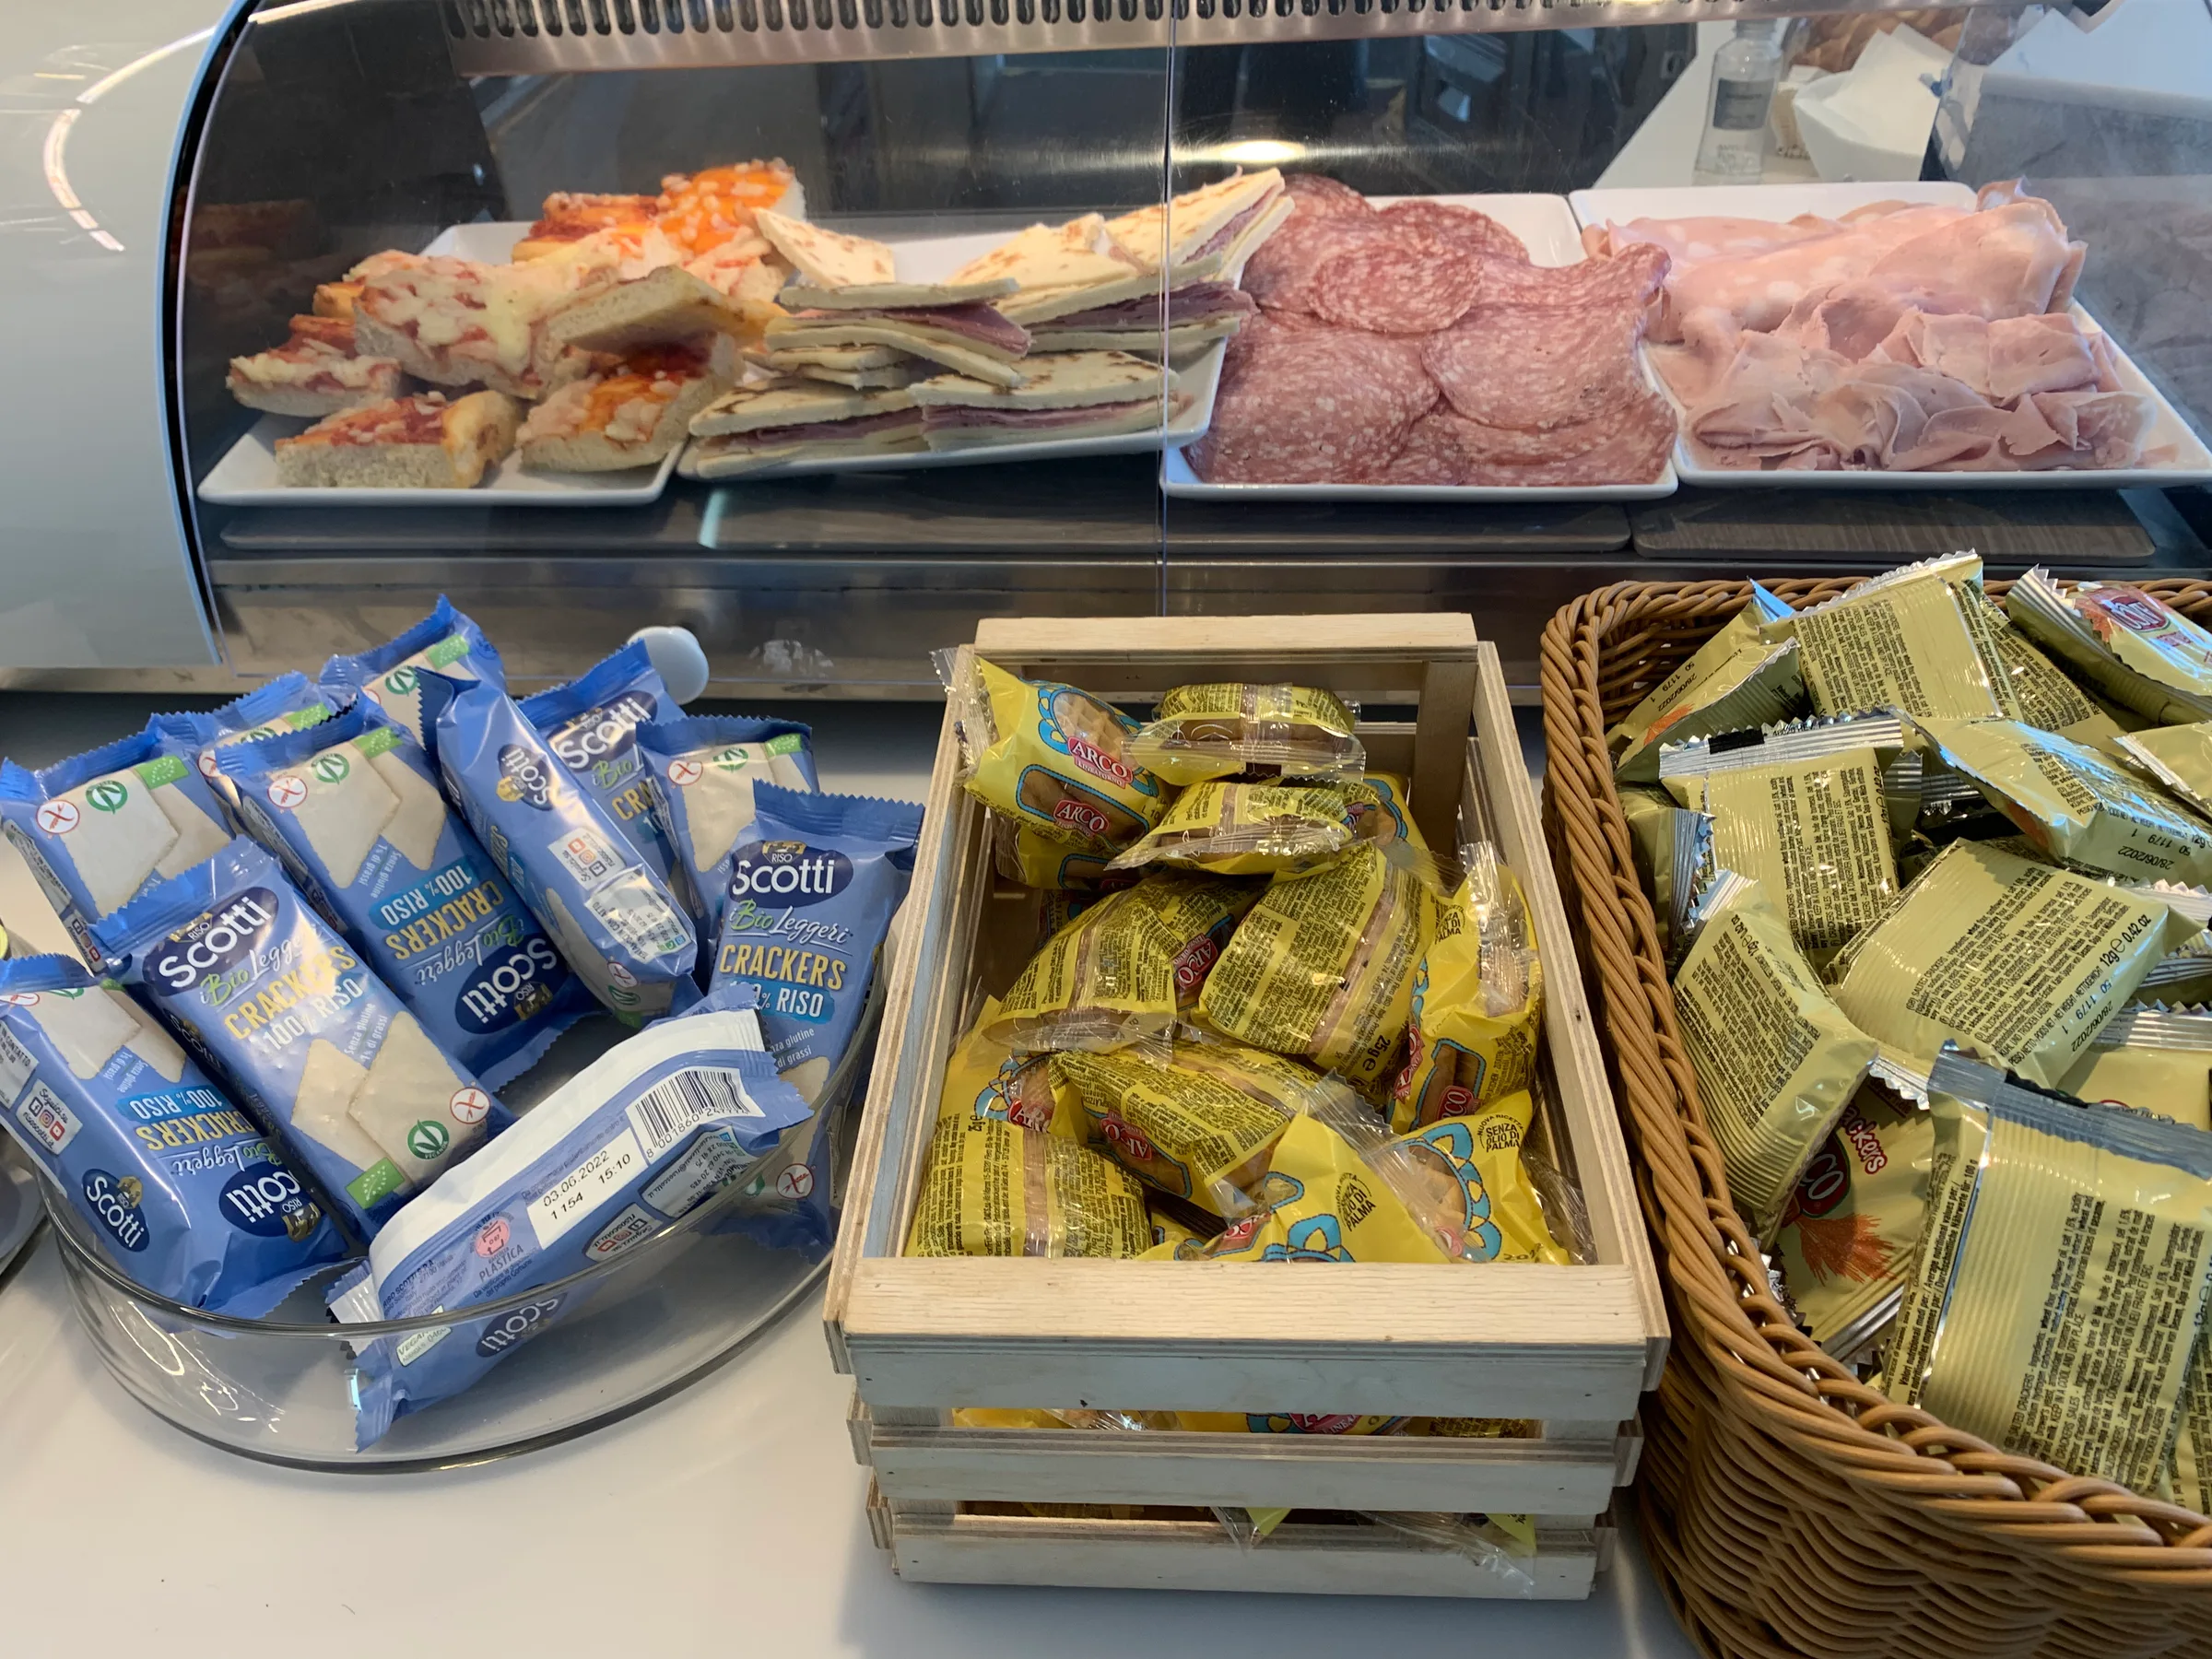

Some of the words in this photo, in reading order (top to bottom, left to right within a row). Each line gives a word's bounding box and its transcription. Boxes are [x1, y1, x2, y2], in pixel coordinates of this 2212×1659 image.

[1656, 671, 1699, 712] 28/06/2022
[1662, 673, 1684, 695] 1179
[558, 697, 651, 769] Scotti
[501, 747, 550, 806] Scotti
[1072, 740, 1129, 778] ARCO
[1056, 802, 1105, 831] ARCO
[387, 851, 402, 875] Senza
[771, 853, 793, 865] RISO
[2118, 844, 2173, 871] 28/06/2022
[2146, 836, 2174, 851] 1179
[2178, 845, 2193, 858] 50
[359, 862, 376, 885] grassi
[371, 871, 389, 898] glutine
[421, 862, 473, 903] 100%
[733, 860, 833, 895] Scotti
[378, 888, 429, 927] RISO
[385, 880, 504, 961] CRACKERS
[159, 895, 272, 988] Scotti
[719, 944, 847, 991] CRACKERS
[1178, 937, 1213, 985] ARCO
[1924, 954, 1947, 979] CRACKERS
[224, 945, 357, 1040] CRACKERS
[313, 978, 363, 1017] RISO
[462, 937, 556, 1024] Scotti
[512, 982, 535, 1001] RISO
[1942, 988, 1968, 1015] CRACKERS
[1962, 973, 1982, 993] SALES
[2007, 1049, 2026, 1067] PESO
[2019, 1037, 2038, 1055] NETTO
[2100, 947, 2122, 969] 12g
[2121, 921, 2145, 947] 0.42
[2136, 913, 2152, 932] oz
[776, 986, 823, 1018] RISO
[2073, 994, 2098, 1019] 1179
[2098, 978, 2113, 994] 50
[344, 1026, 362, 1055] Senza
[371, 1015, 388, 1042] grassi
[783, 1027, 816, 1046] glutine
[2008, 1031, 2023, 1046] UND
[2017, 1014, 2040, 1037] TROCKEN
[2066, 1000, 2117, 1053] 28/06/2022
[785, 1045, 813, 1065] grassi
[36, 1087, 64, 1116] Seguici
[128, 1093, 179, 1122] RISO
[176, 1086, 223, 1115] 100%
[136, 1112, 254, 1150] CRACKERS
[644, 1147, 654, 1158] 8
[657, 1113, 700, 1148] 001860
[1486, 1124, 1517, 1138] SENZA
[1486, 1135, 1505, 1148] OLIO
[1506, 1132, 1521, 1143] DI
[1486, 1136, 1522, 1153] PALMA
[1843, 1104, 1888, 1175] ackers
[538, 1149, 612, 1207] 03.06.2022
[595, 1153, 633, 1184] 15:10
[1802, 1150, 1844, 1202] CO
[86, 1176, 146, 1247] Scotti
[227, 1170, 301, 1224] cotti
[282, 1198, 302, 1213] RISO
[1940, 1201, 1955, 1224] values
[1346, 1200, 1376, 1231] PALMA
[1920, 1308, 1939, 1344] moyennes
[1933, 1229, 1959, 1288] Durchschnittliche
[1963, 1164, 1976, 1179] 100
[1931, 1224, 1949, 1259] nutritional
[479, 1243, 524, 1281] PLASTICA
[1924, 1259, 1940, 1288] Average
[480, 1298, 559, 1353] Scotti
[1913, 1307, 1925, 1325] medi
[1902, 1325, 1922, 1364] nutrizionali
[1897, 1364, 1911, 1385] Valori
[2016, 1372, 2035, 1411] CRACKERS
[2049, 1404, 2063, 1422] KEEP
[2062, 1352, 2075, 1368] AND
[2065, 1395, 2080, 1419] SALES
